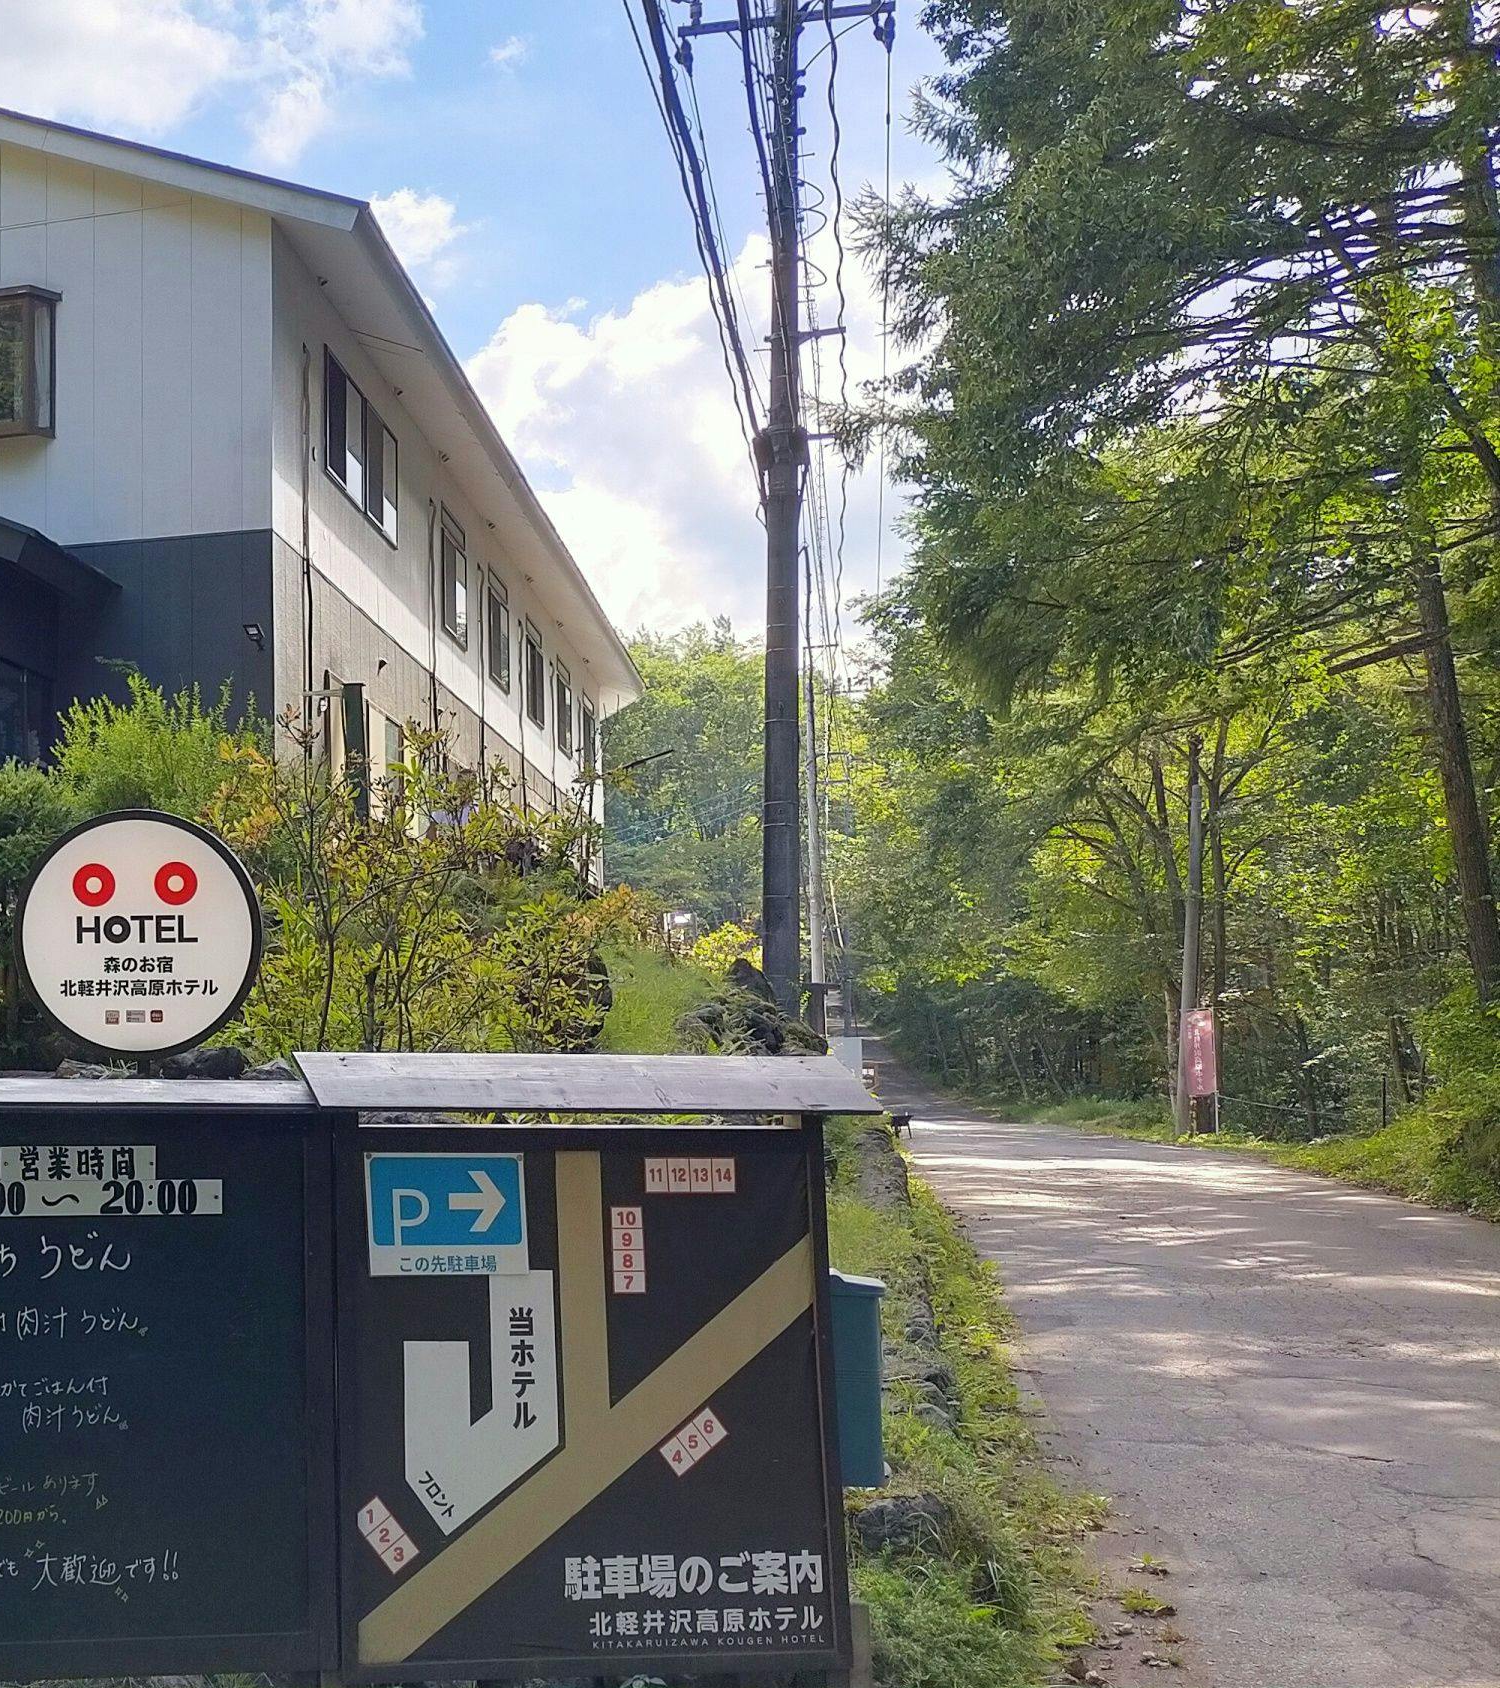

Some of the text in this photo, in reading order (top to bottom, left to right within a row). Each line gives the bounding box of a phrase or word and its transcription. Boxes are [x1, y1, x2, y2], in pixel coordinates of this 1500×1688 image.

[76, 914, 199, 944] HOTEL
[103, 955, 174, 974] 森のお宿
[60, 978, 219, 998] 北軽井沢高原ホテル
[19, 1146, 136, 1181] 営業時間
[649, 1168, 732, 1182] 11 12 13 14
[100, 1179, 199, 1215] 20:00
[392, 1188, 430, 1248] P
[617, 1211, 636, 1226] 10
[40, 1231, 131, 1279] うどん
[621, 1232, 633, 1247] 9
[399, 1254, 497, 1273] この先駐車場
[622, 1253, 634, 1268] 8
[623, 1275, 634, 1290] 7
[509, 1306, 538, 1430] 当ホテル
[671, 1419, 714, 1464] 4 5 6
[418, 1470, 455, 1517] フロント
[366, 1508, 405, 1562] 1 2 3
[564, 1549, 824, 1601] 駐車場のご案内
[589, 1605, 823, 1637] 北軽井沢高原ホテル
[592, 1634, 825, 1649] KITAKARUIZAWA KOUGEN HOTEL
